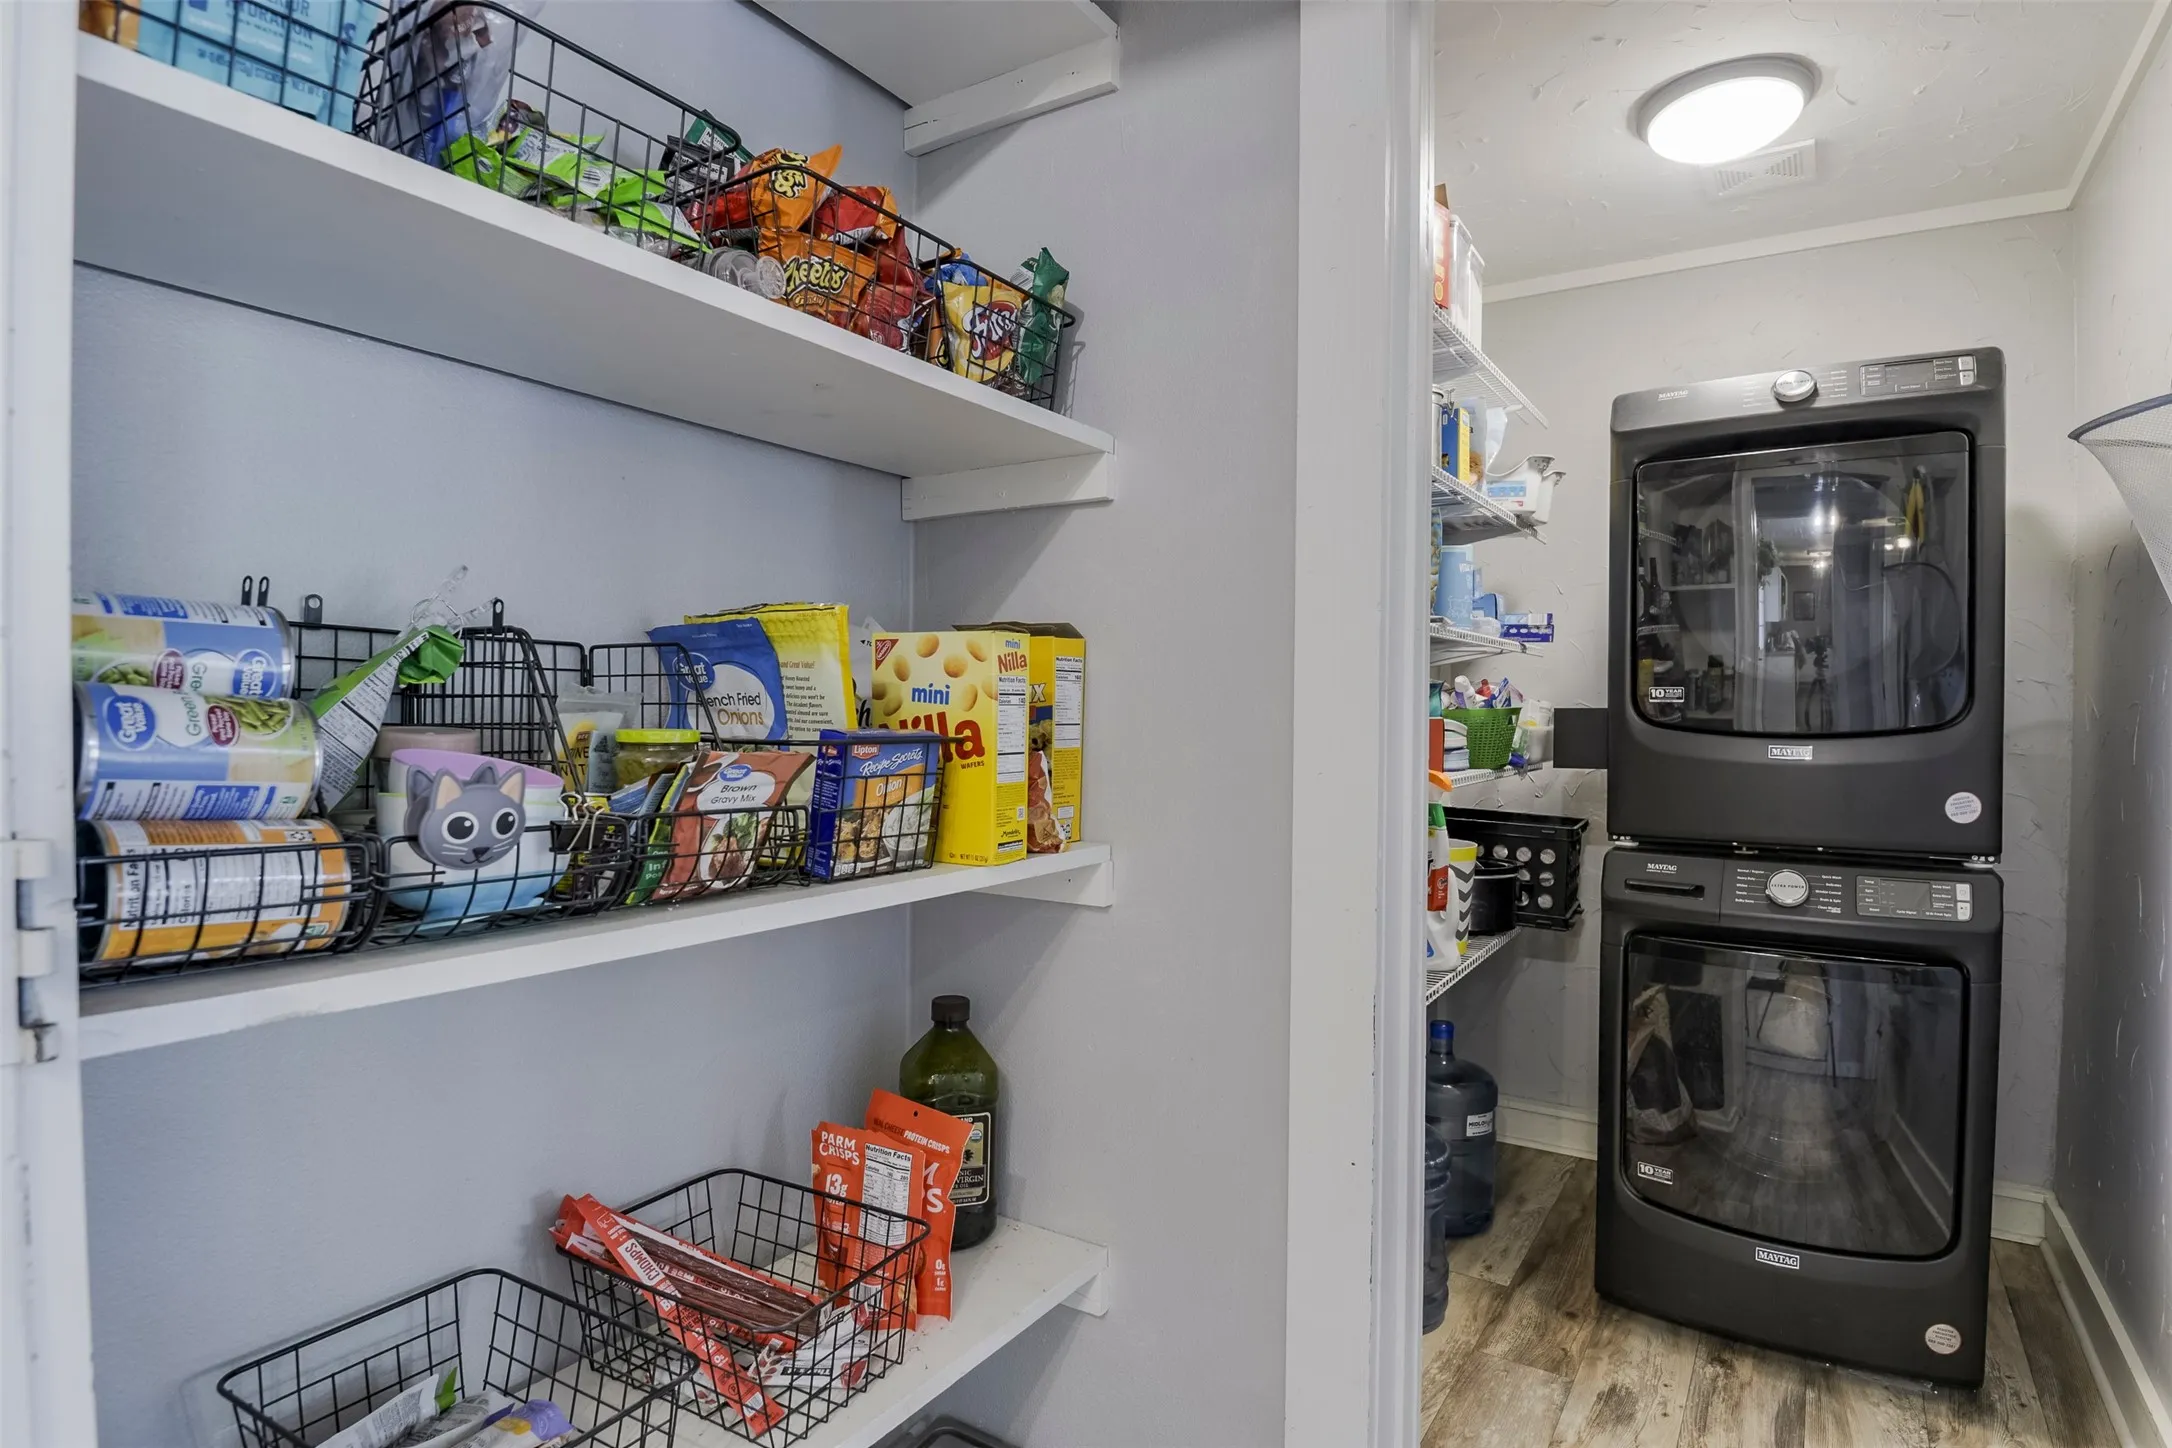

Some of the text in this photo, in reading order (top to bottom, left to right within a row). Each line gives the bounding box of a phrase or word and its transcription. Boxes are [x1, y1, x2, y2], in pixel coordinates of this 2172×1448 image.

[1658, 389, 1688, 399] MAYTAG
[1005, 638, 1021, 649] mini
[679, 662, 706, 676] Grat
[997, 651, 1028, 673] Nilla
[191, 661, 208, 693] Gre
[252, 656, 266, 698] Great
[736, 692, 761, 706] Fried
[912, 683, 950, 705] mini
[1651, 689, 1665, 698] 10
[115, 701, 137, 743] Great
[184, 692, 201, 736] Green
[717, 708, 764, 726] Onions
[878, 711, 985, 762] lla
[854, 745, 878, 755] Lipton
[1771, 748, 1811, 757] MAYTAG
[859, 748, 924, 776] Recipe Secrets
[960, 760, 985, 770] WAFERS
[720, 784, 757, 793] Brown
[711, 794, 757, 805] Gravy Mix
[1647, 863, 1677, 871] MAYTAG
[821, 1131, 856, 1150] PARM
[884, 1122, 905, 1137] CHEESE
[904, 1130, 928, 1146] PROTEIN
[928, 1139, 951, 1154] CRISPS
[819, 1142, 860, 1165] CRISPS
[865, 1144, 911, 1162] Nutrition Facts
[1640, 1164, 1654, 1175] 10
[825, 1173, 848, 1197] 13g
[956, 1174, 984, 1184] VIRGIN
[625, 1242, 660, 1282] CHOMPS
[1758, 1251, 1797, 1266] MAYTAG
